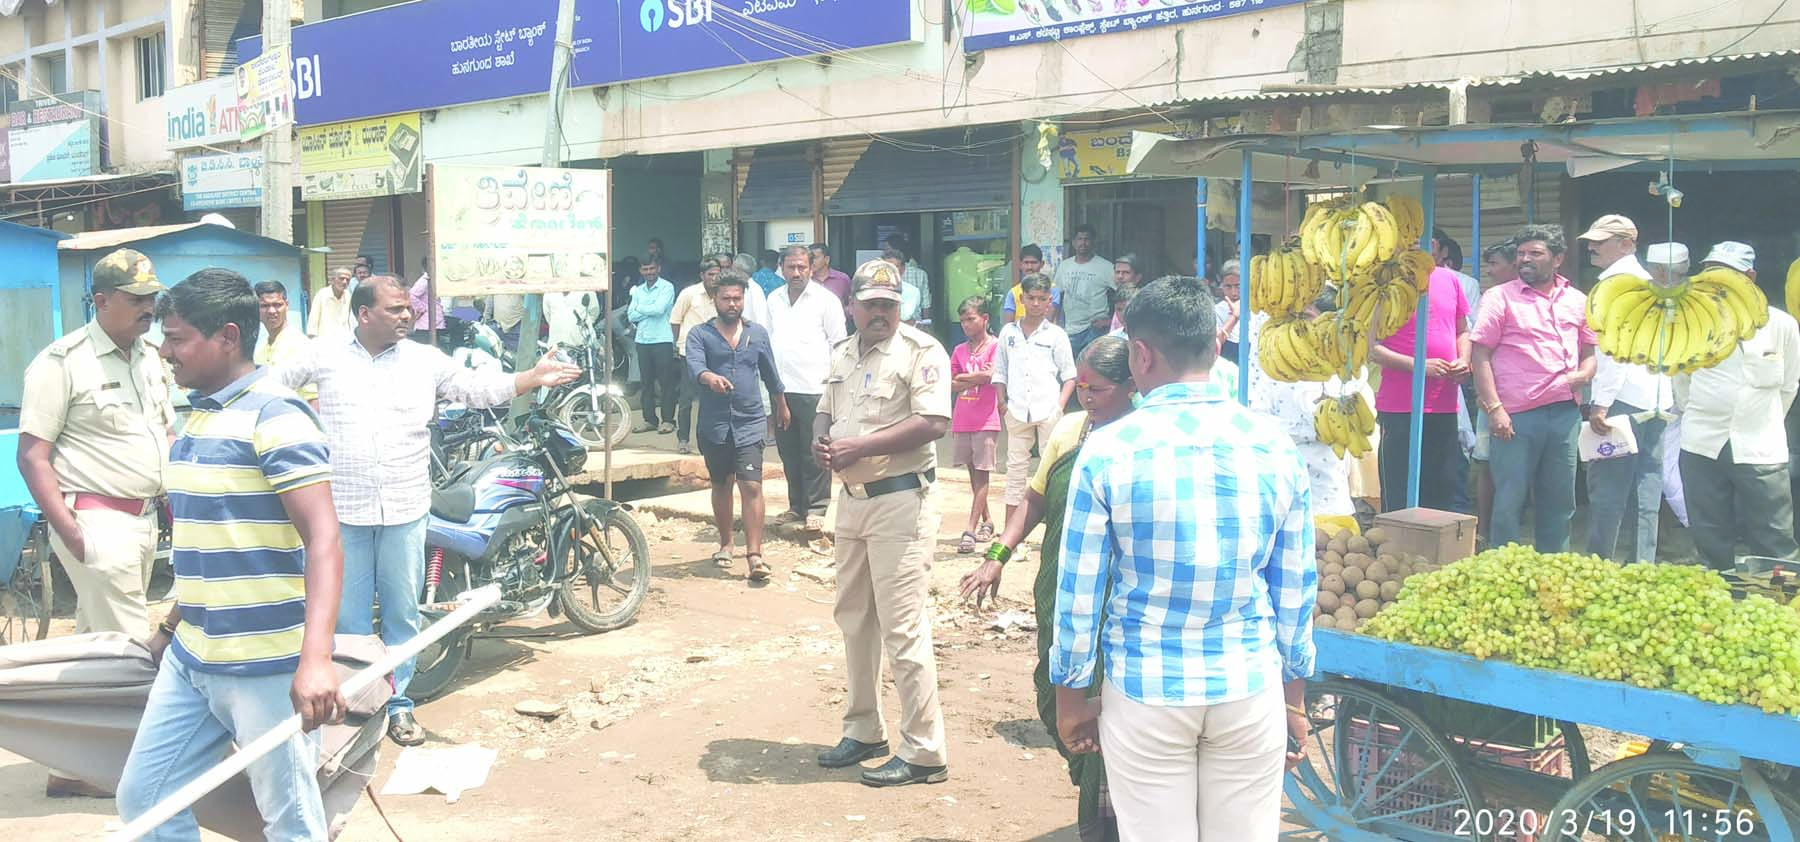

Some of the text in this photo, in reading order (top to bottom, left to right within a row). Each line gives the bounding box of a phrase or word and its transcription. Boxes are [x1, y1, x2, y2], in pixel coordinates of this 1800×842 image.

[668, 0, 713, 28] SBI
[518, 21, 546, 46] ಬ್ಯಾಂಕ್
[291, 54, 323, 100] BI
[451, 55, 492, 75] ಹುನಗುಂದ
[167, 104, 206, 142] india
